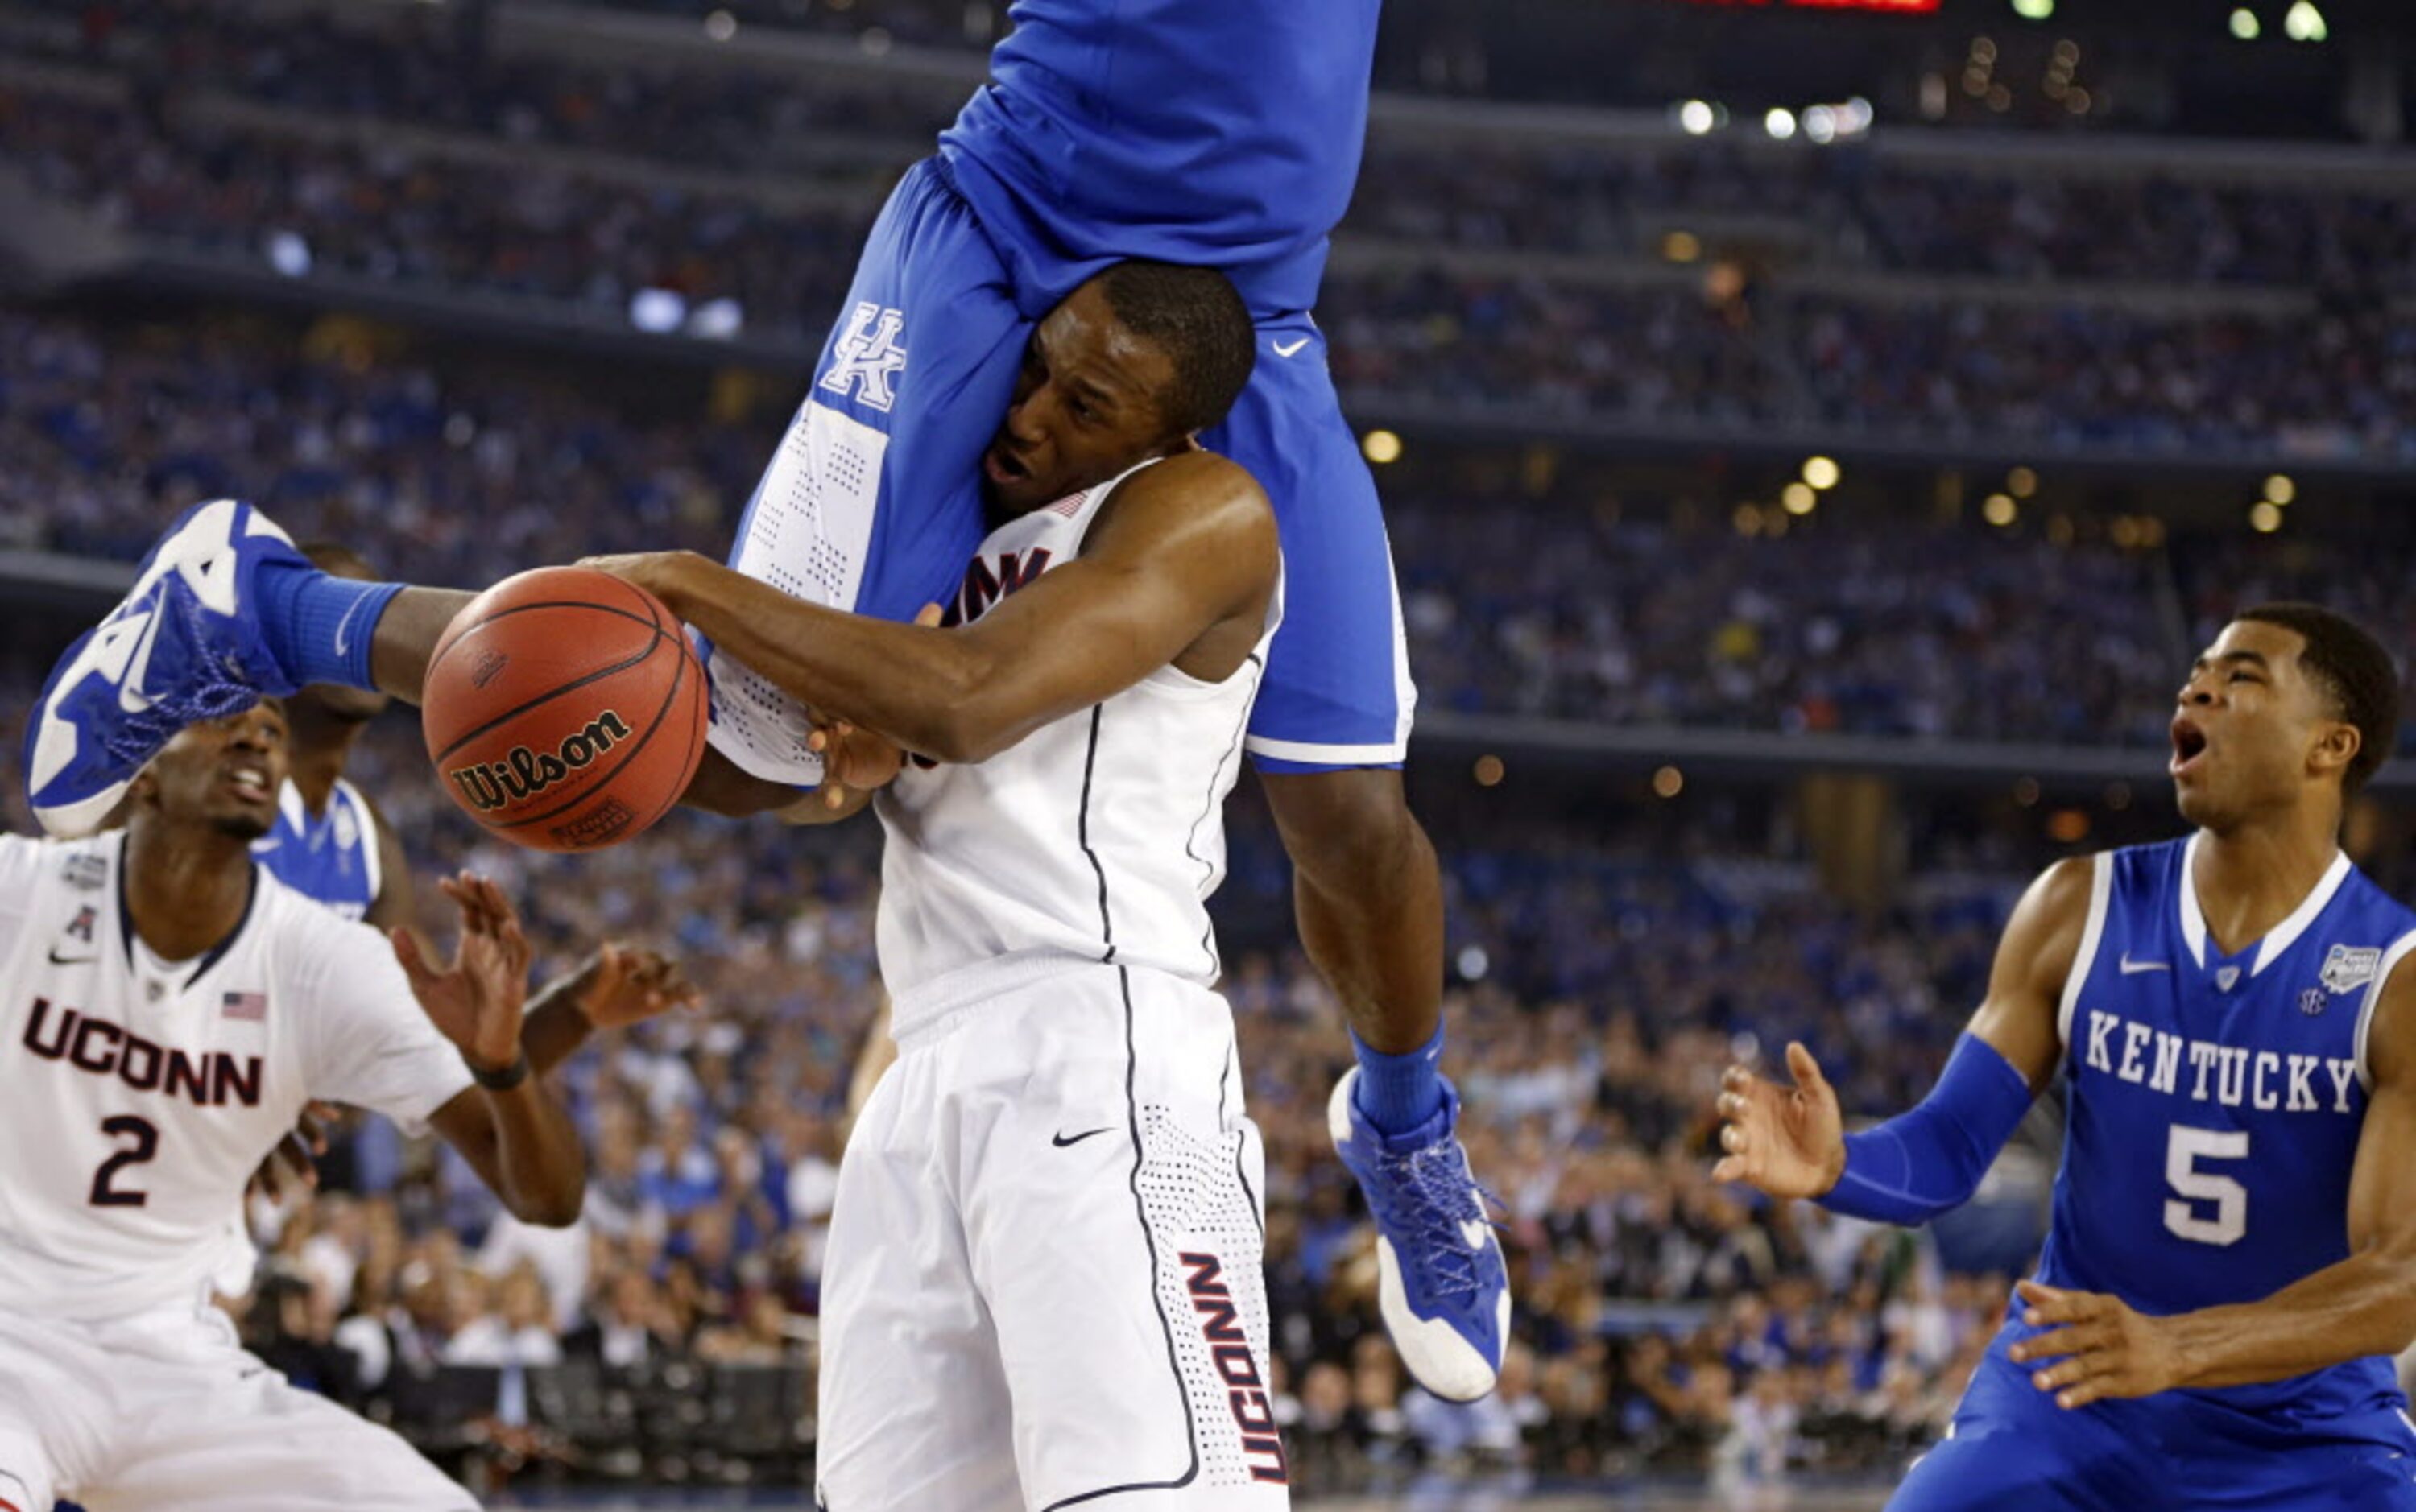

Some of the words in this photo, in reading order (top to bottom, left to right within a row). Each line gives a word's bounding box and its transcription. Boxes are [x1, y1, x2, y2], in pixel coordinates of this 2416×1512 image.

[451, 708, 633, 811] Wilson
[23, 996, 263, 1107] UCONN
[2086, 1010, 2357, 1112] KENTUCKY
[89, 1116, 160, 1208] 2
[2163, 1124, 2249, 1248] 5
[1179, 1251, 1288, 1485] UCONN
